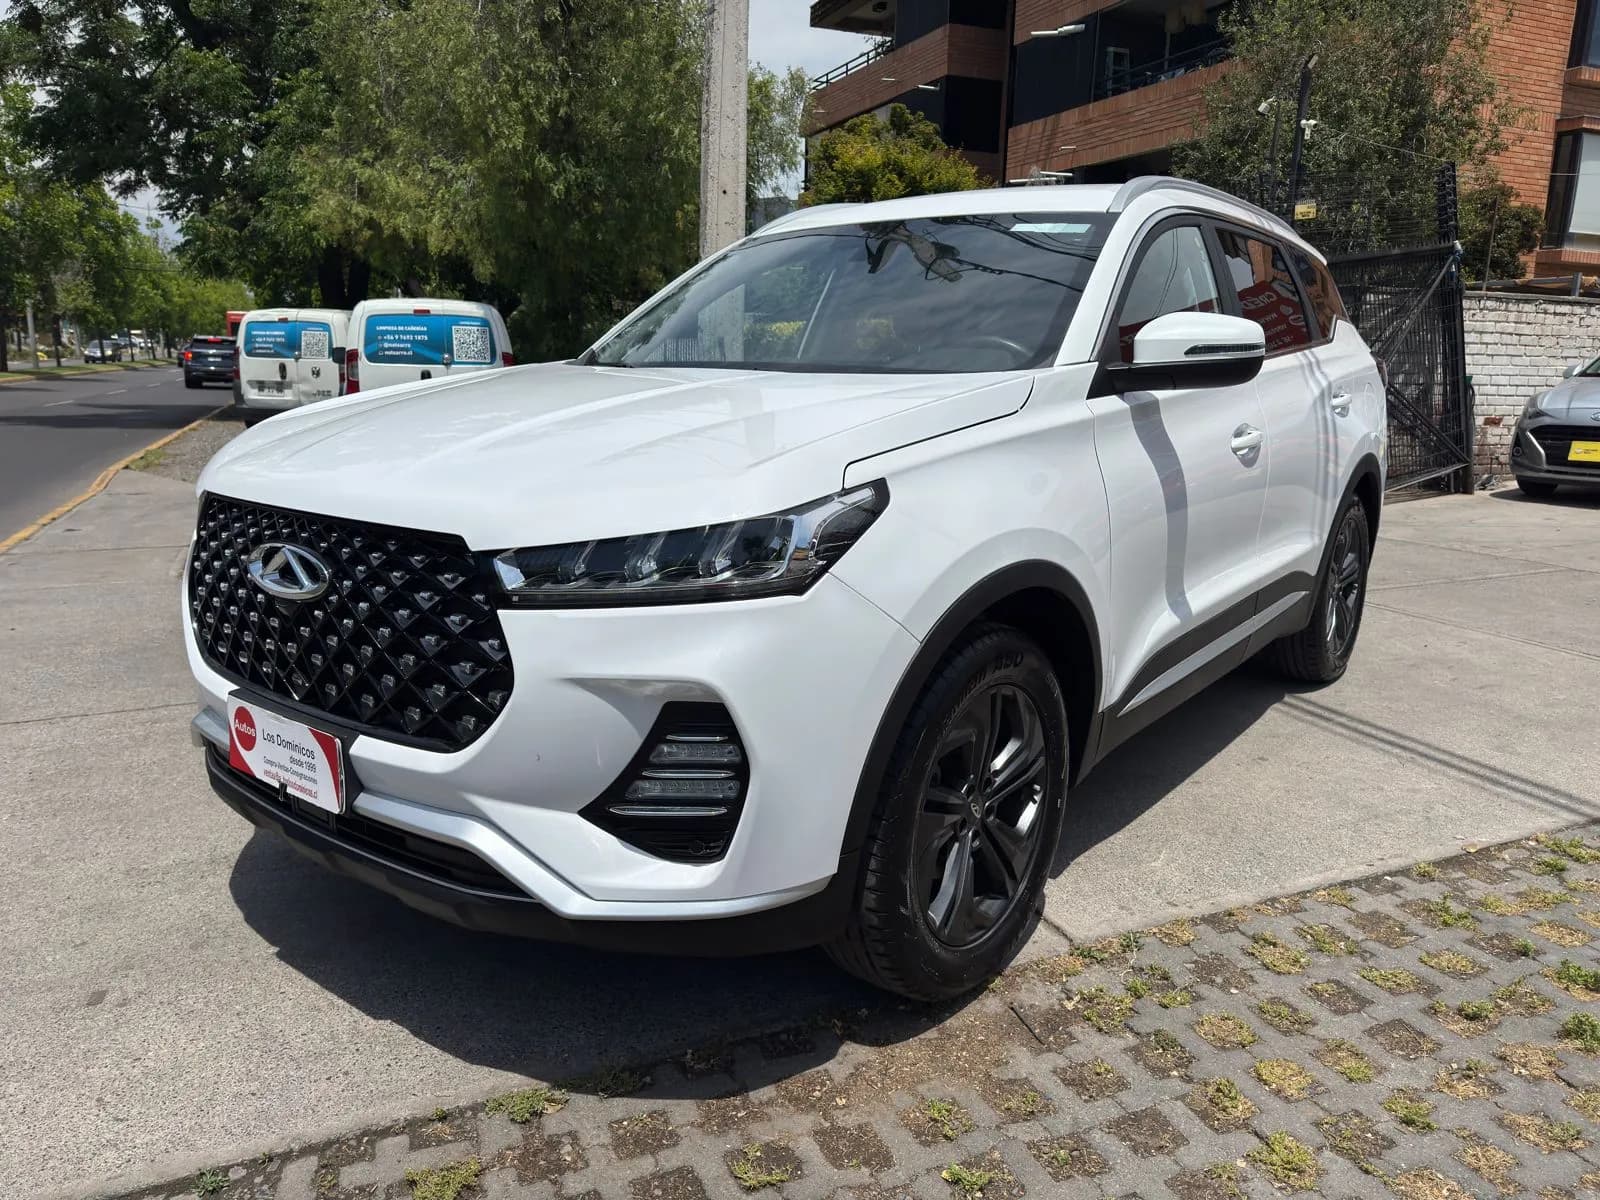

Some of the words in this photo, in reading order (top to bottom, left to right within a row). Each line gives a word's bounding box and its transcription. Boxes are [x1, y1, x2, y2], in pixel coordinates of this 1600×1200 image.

[234, 719, 256, 737] Autos
[262, 728, 275, 744] Los
[276, 734, 316, 760] Dominicos
[289, 755, 304, 768] desde
